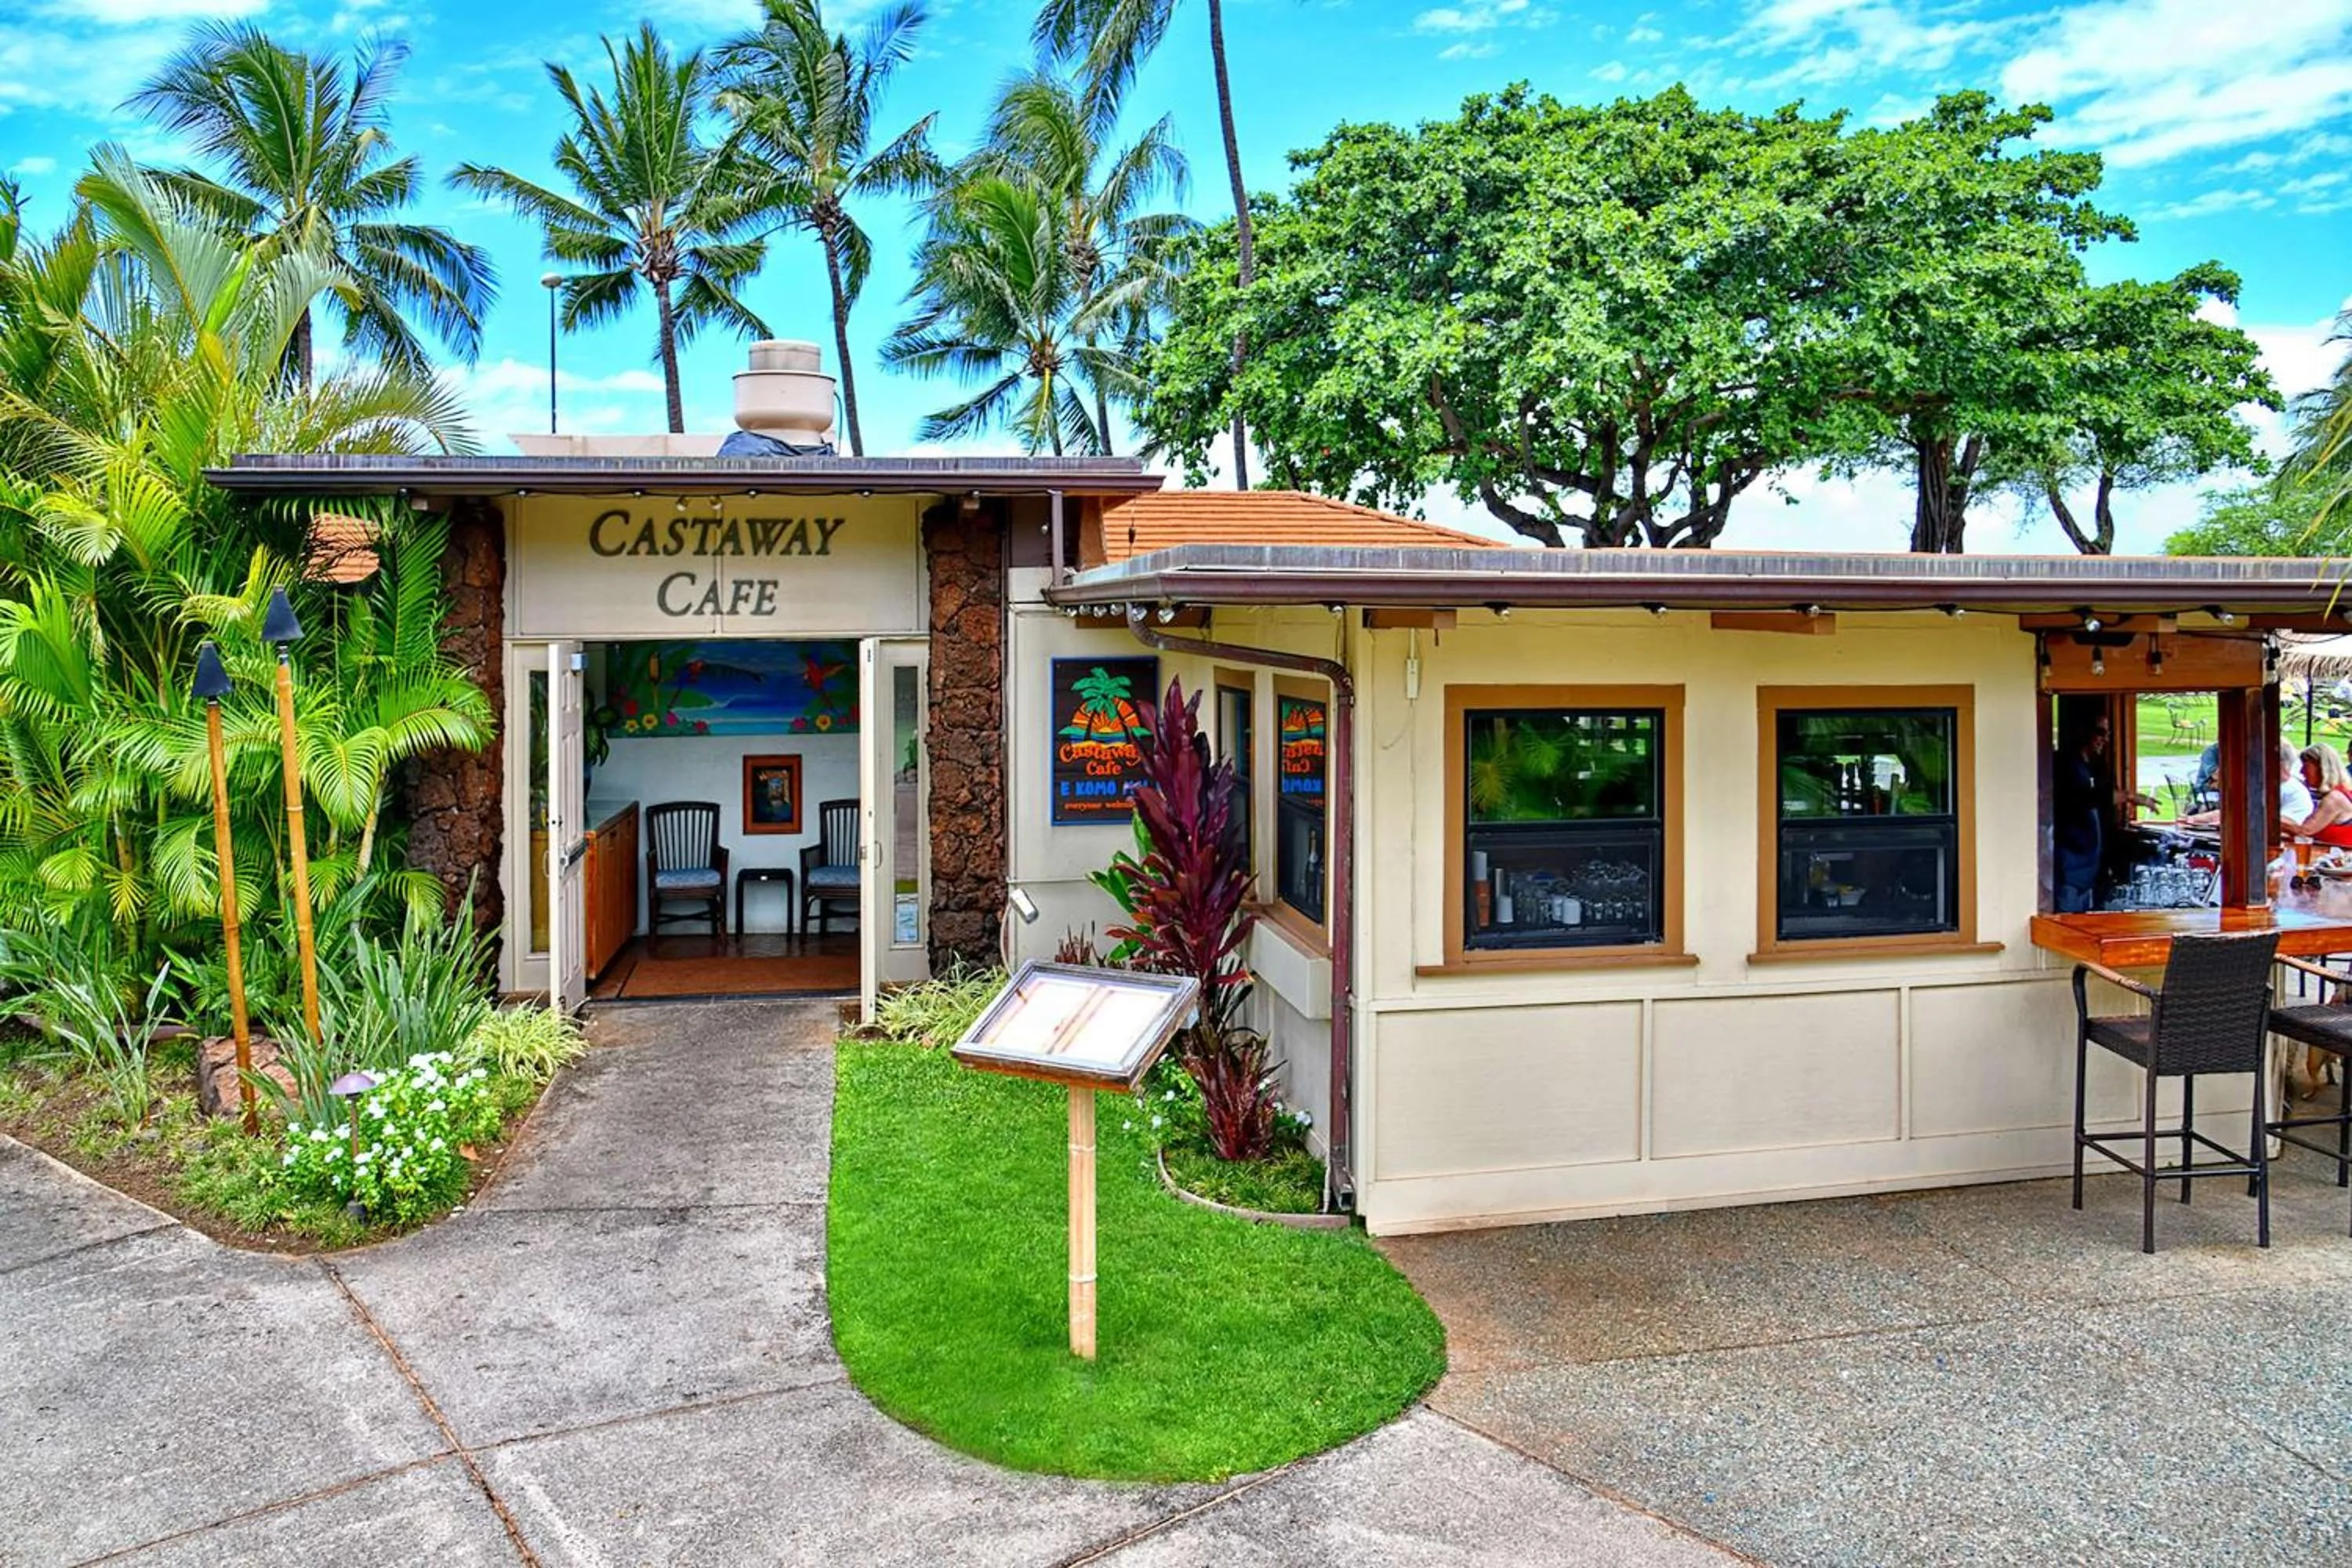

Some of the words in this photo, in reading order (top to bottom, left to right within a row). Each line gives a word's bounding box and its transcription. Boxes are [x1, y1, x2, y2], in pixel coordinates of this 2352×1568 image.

[589, 510, 845, 557] CASTAWAY
[657, 572, 779, 616] CAFE
[1086, 760, 1122, 775] Cafe
[1060, 781, 1071, 797] E
[1075, 780, 1117, 796] KOMO
